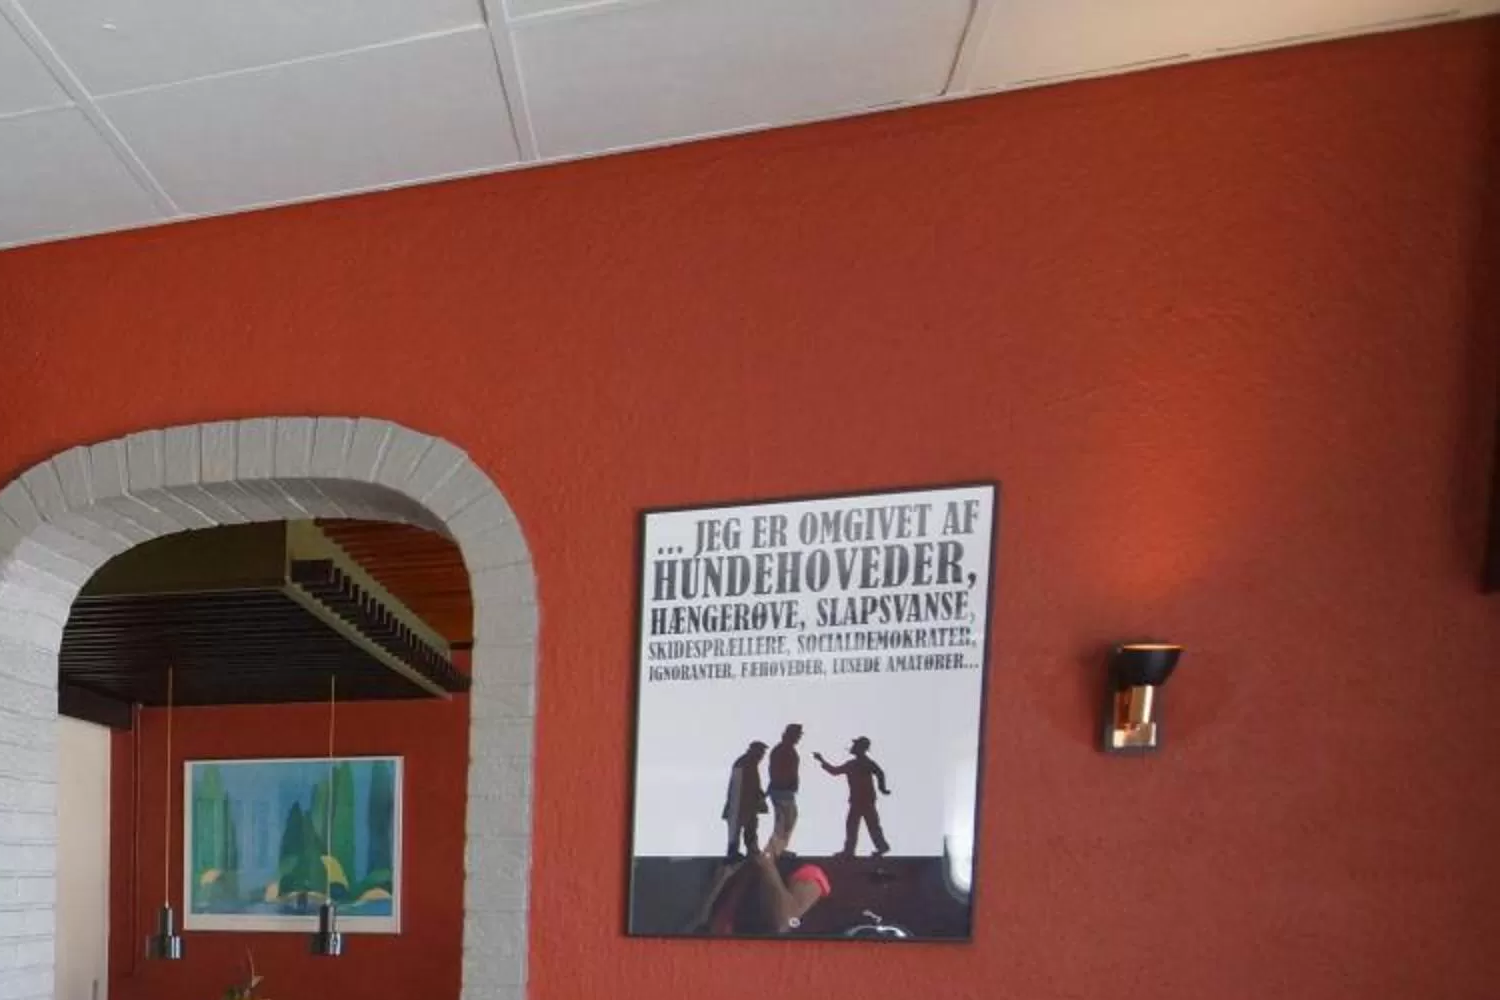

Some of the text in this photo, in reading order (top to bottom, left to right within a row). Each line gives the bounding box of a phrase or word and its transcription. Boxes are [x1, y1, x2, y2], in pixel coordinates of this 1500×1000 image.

[695, 517, 741, 557] JEG
[752, 514, 788, 549] ER
[799, 503, 932, 545] OMGIVET
[942, 499, 980, 536] AF
[652, 540, 977, 601] HUNDEHOVEDER,
[651, 591, 976, 635] HÆNGERØVE, SLAPSVANSE,
